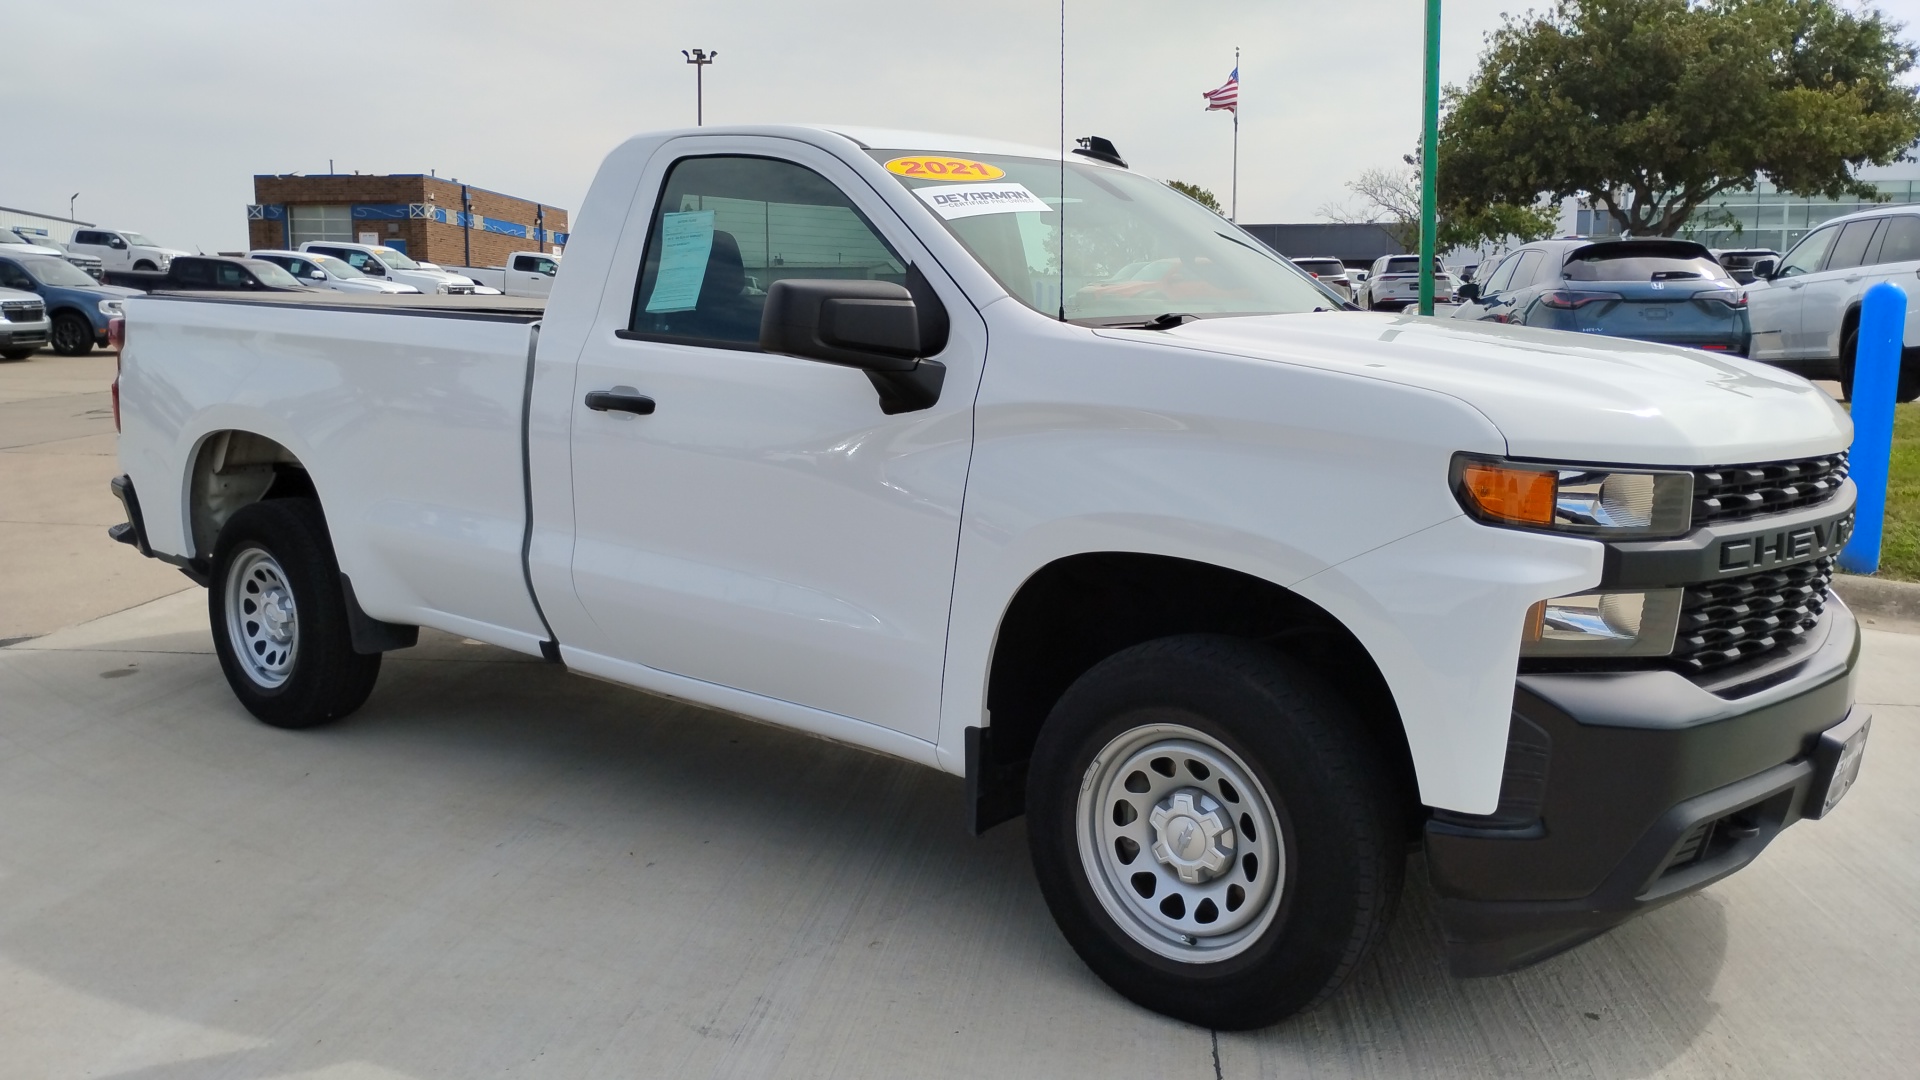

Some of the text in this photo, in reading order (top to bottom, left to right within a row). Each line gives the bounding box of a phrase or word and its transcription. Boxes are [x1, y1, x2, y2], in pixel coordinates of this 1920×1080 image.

[900, 161, 990, 176] 2021
[933, 191, 1030, 205] DEYARMAN
[949, 200, 990, 208] CERTIFIED
